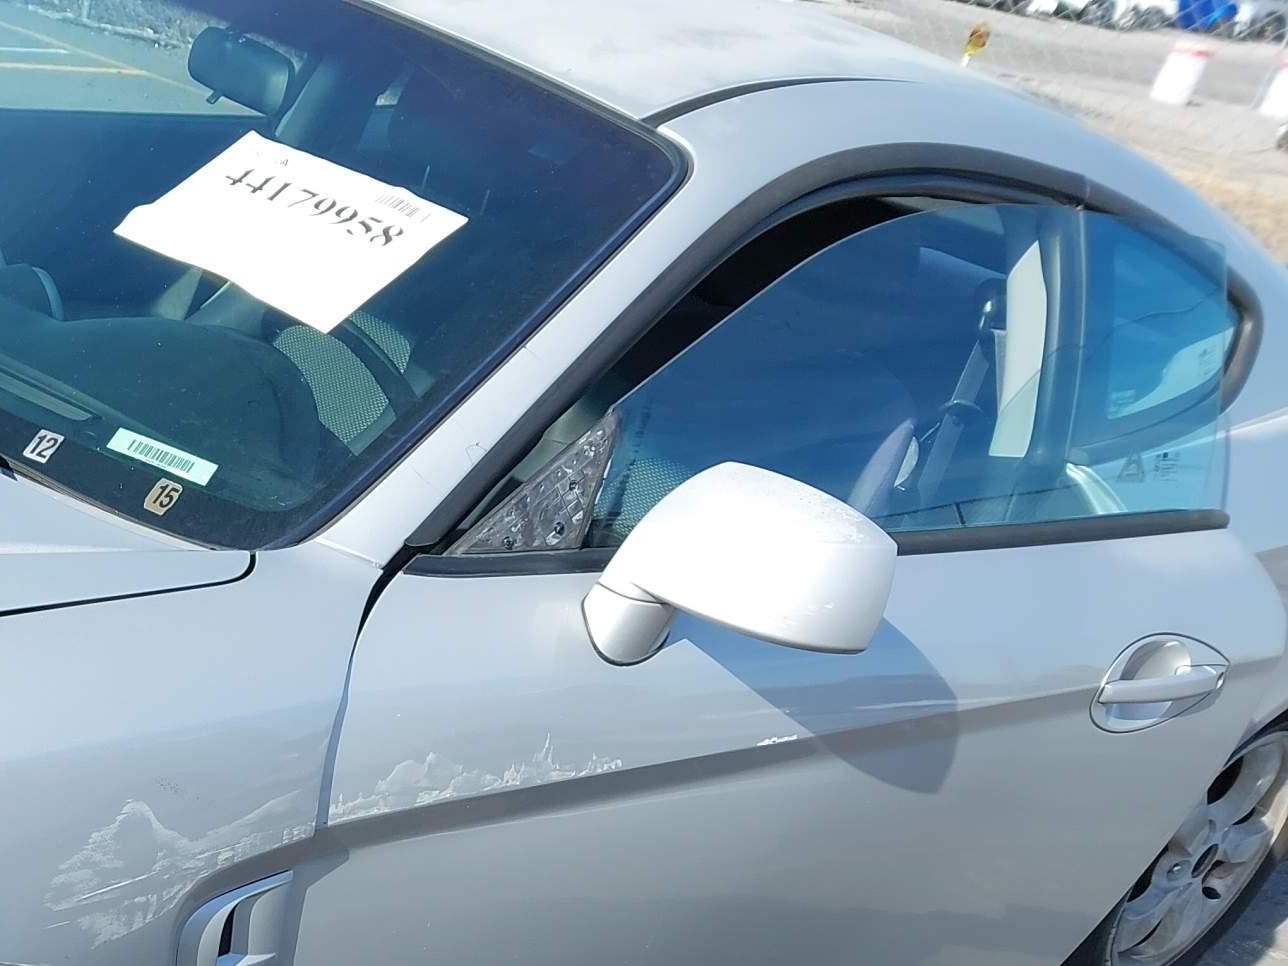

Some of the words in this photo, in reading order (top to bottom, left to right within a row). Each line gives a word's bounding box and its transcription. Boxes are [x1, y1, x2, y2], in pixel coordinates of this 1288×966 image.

[224, 168, 404, 247] 44179958
[30, 434, 59, 459] 12
[152, 484, 180, 508] 15
